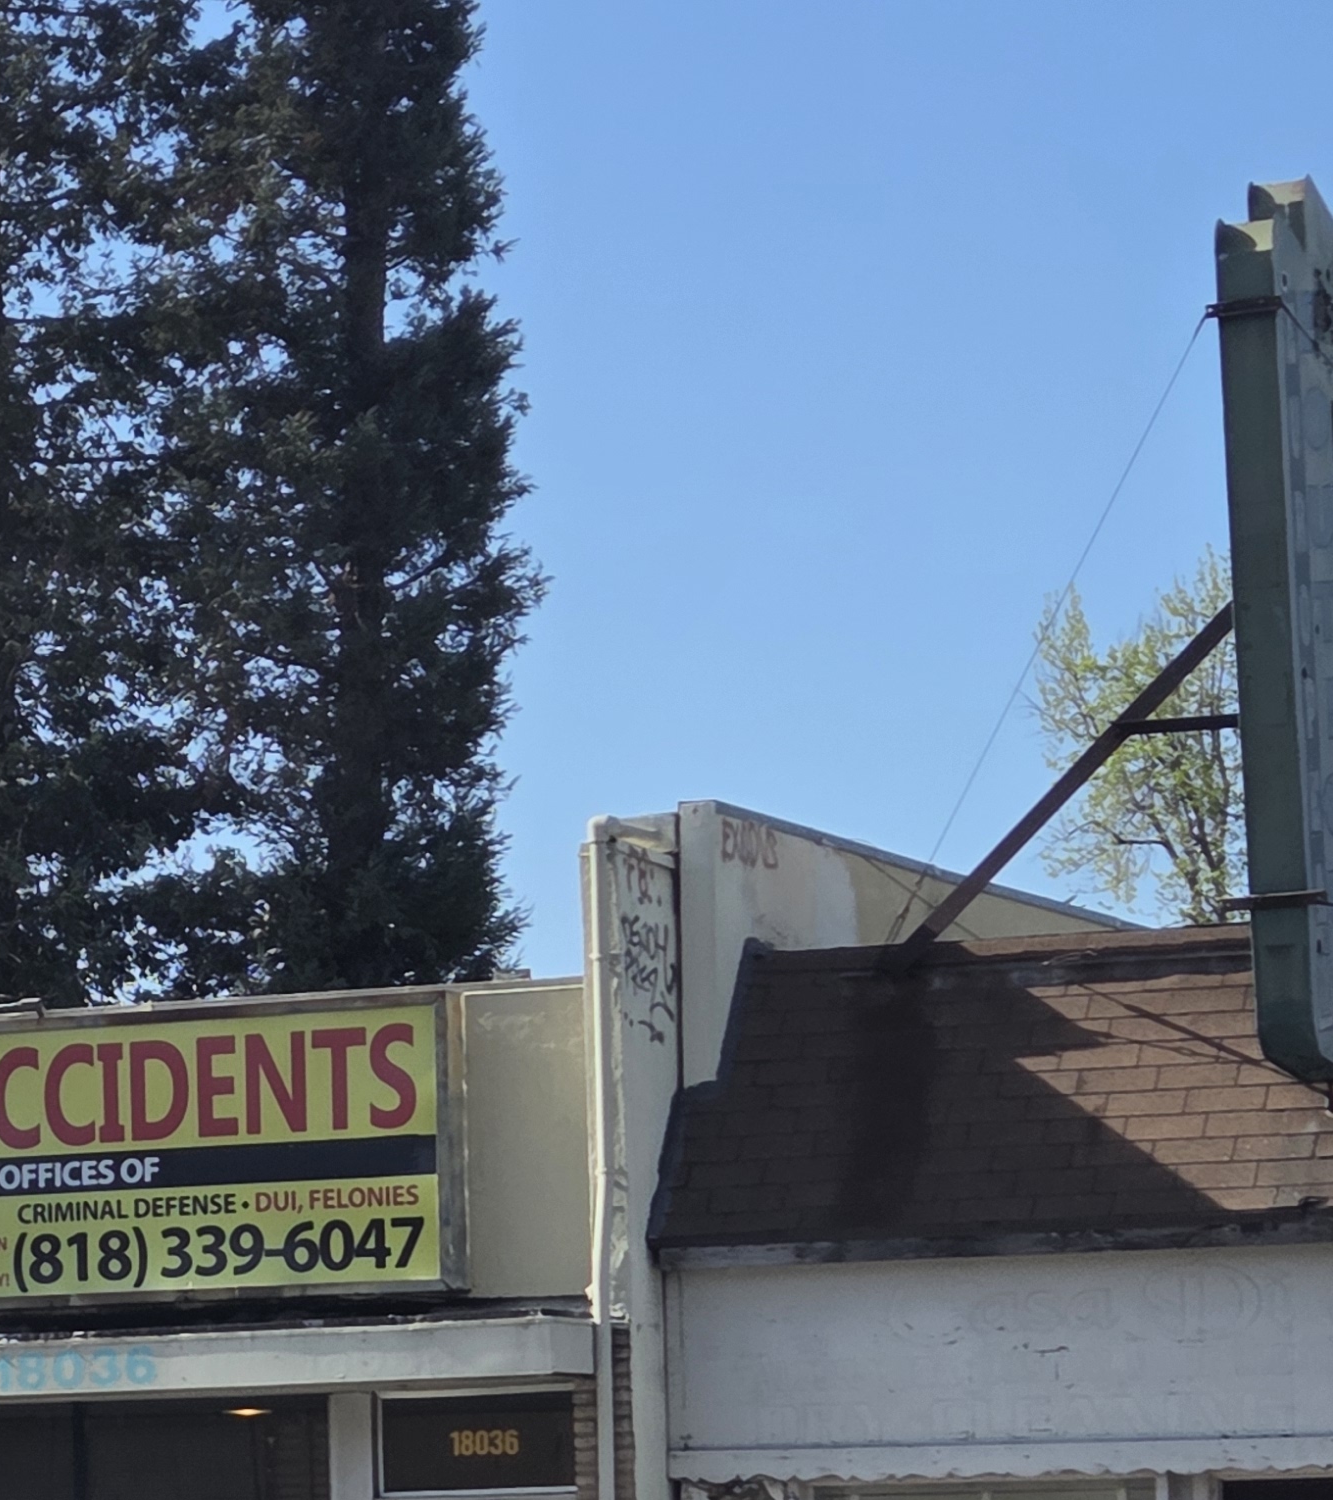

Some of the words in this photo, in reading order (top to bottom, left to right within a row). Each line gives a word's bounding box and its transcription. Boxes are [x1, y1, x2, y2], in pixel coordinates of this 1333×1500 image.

[120, 1156, 160, 1183] OF
[16, 1199, 129, 1225] CRIMINAL
[133, 1194, 237, 1218] DEFENSE
[254, 1190, 303, 1215] DUI,
[309, 1184, 420, 1211] FELONIES
[13, 1226, 149, 1293] (818)
[159, 1216, 425, 1278] 339-6047
[449, 1429, 520, 1456] 18036
